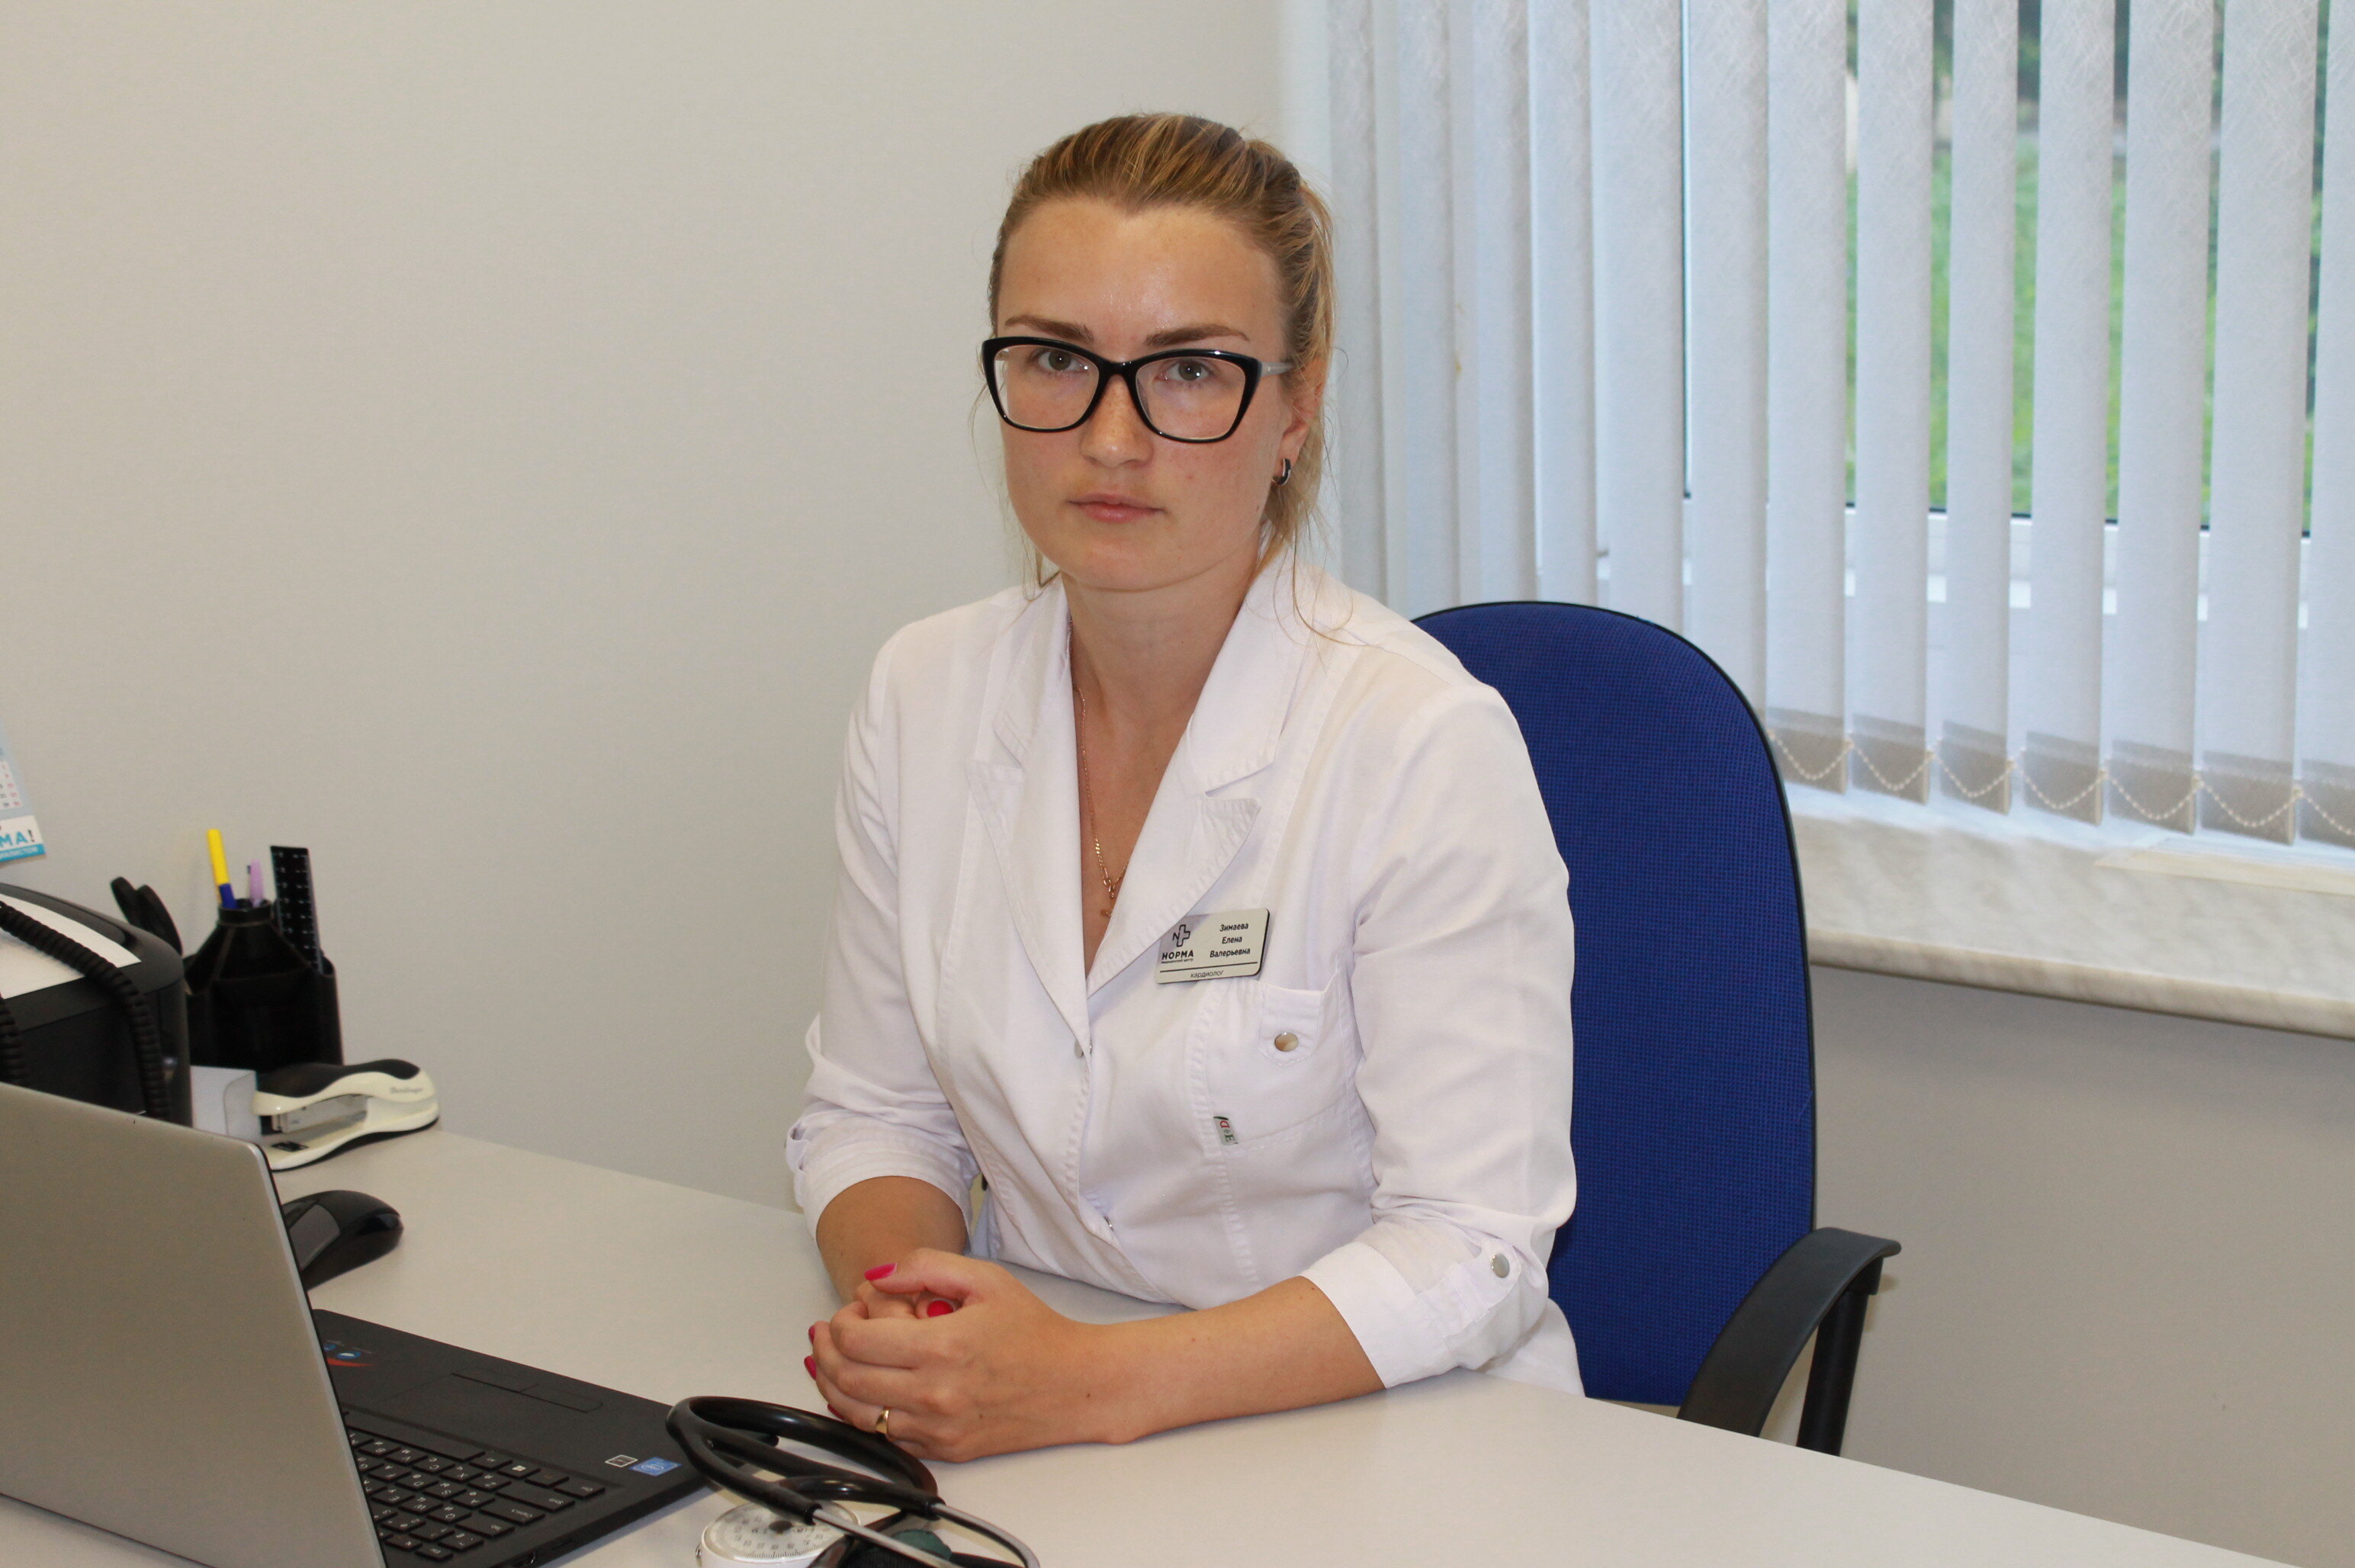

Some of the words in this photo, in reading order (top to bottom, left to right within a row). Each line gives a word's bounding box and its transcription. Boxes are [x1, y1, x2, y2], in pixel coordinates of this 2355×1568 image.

[1162, 950, 1194, 960] НОРМА
[1210, 949, 1250, 957] Валерьевна
[1190, 970, 1224, 978] кардиолог
